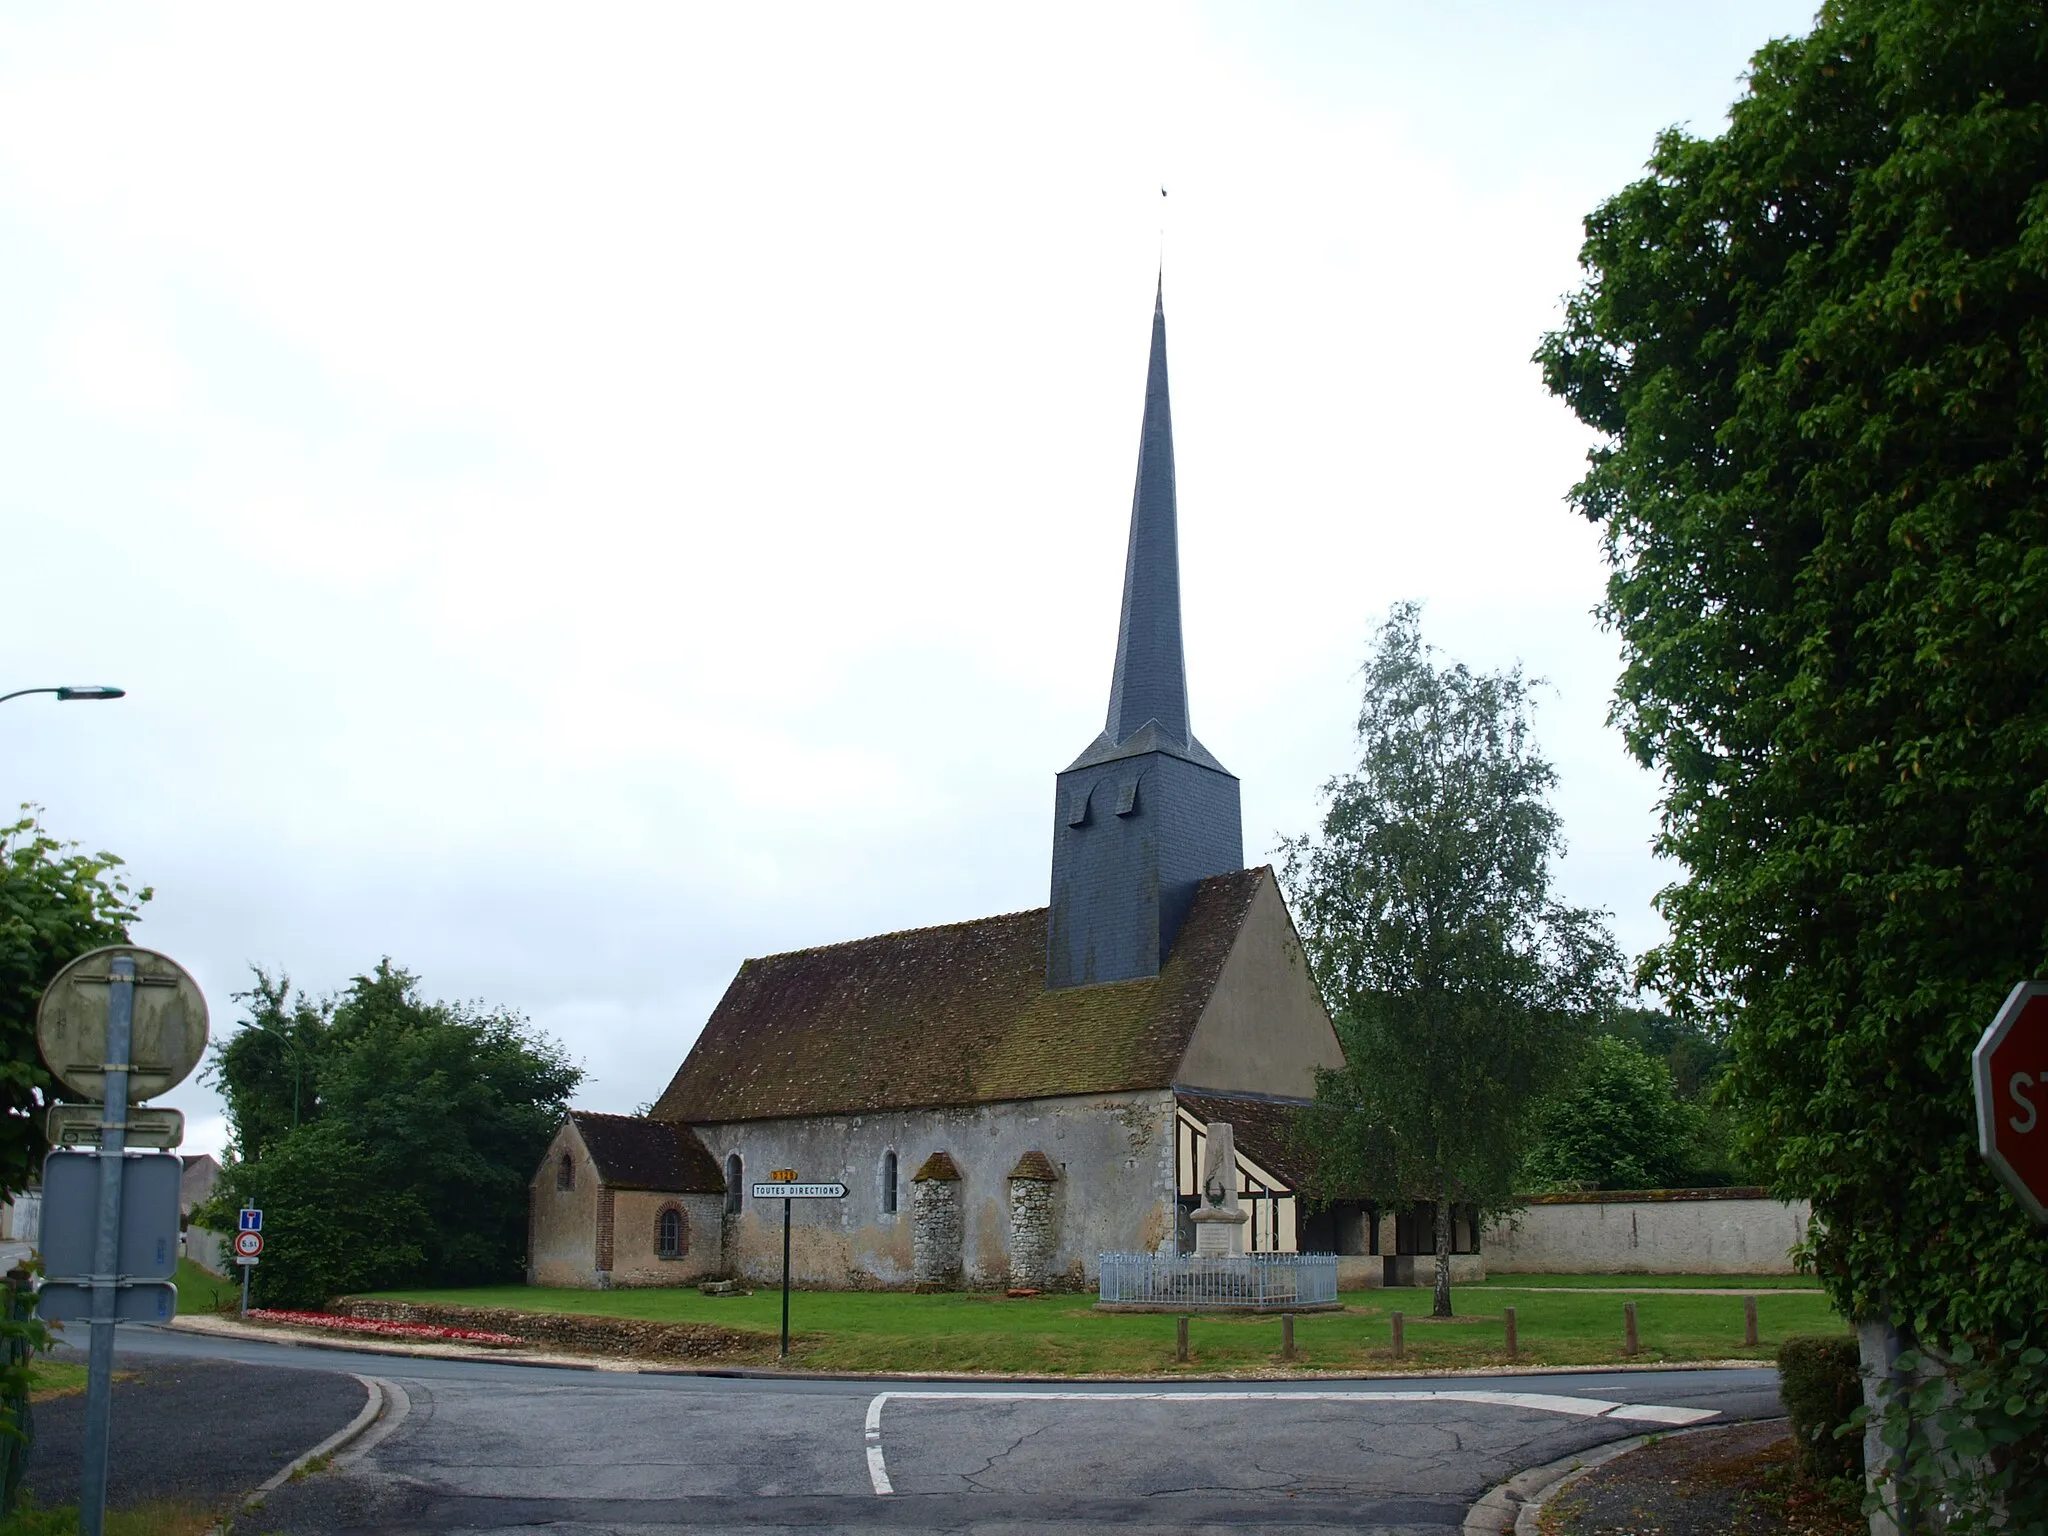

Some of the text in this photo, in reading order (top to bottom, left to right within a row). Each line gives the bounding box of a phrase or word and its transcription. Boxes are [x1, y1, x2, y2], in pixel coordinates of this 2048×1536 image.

[2009, 1072, 2048, 1133] S
[756, 1187, 840, 1195] TOUTES DIRECTIONS
